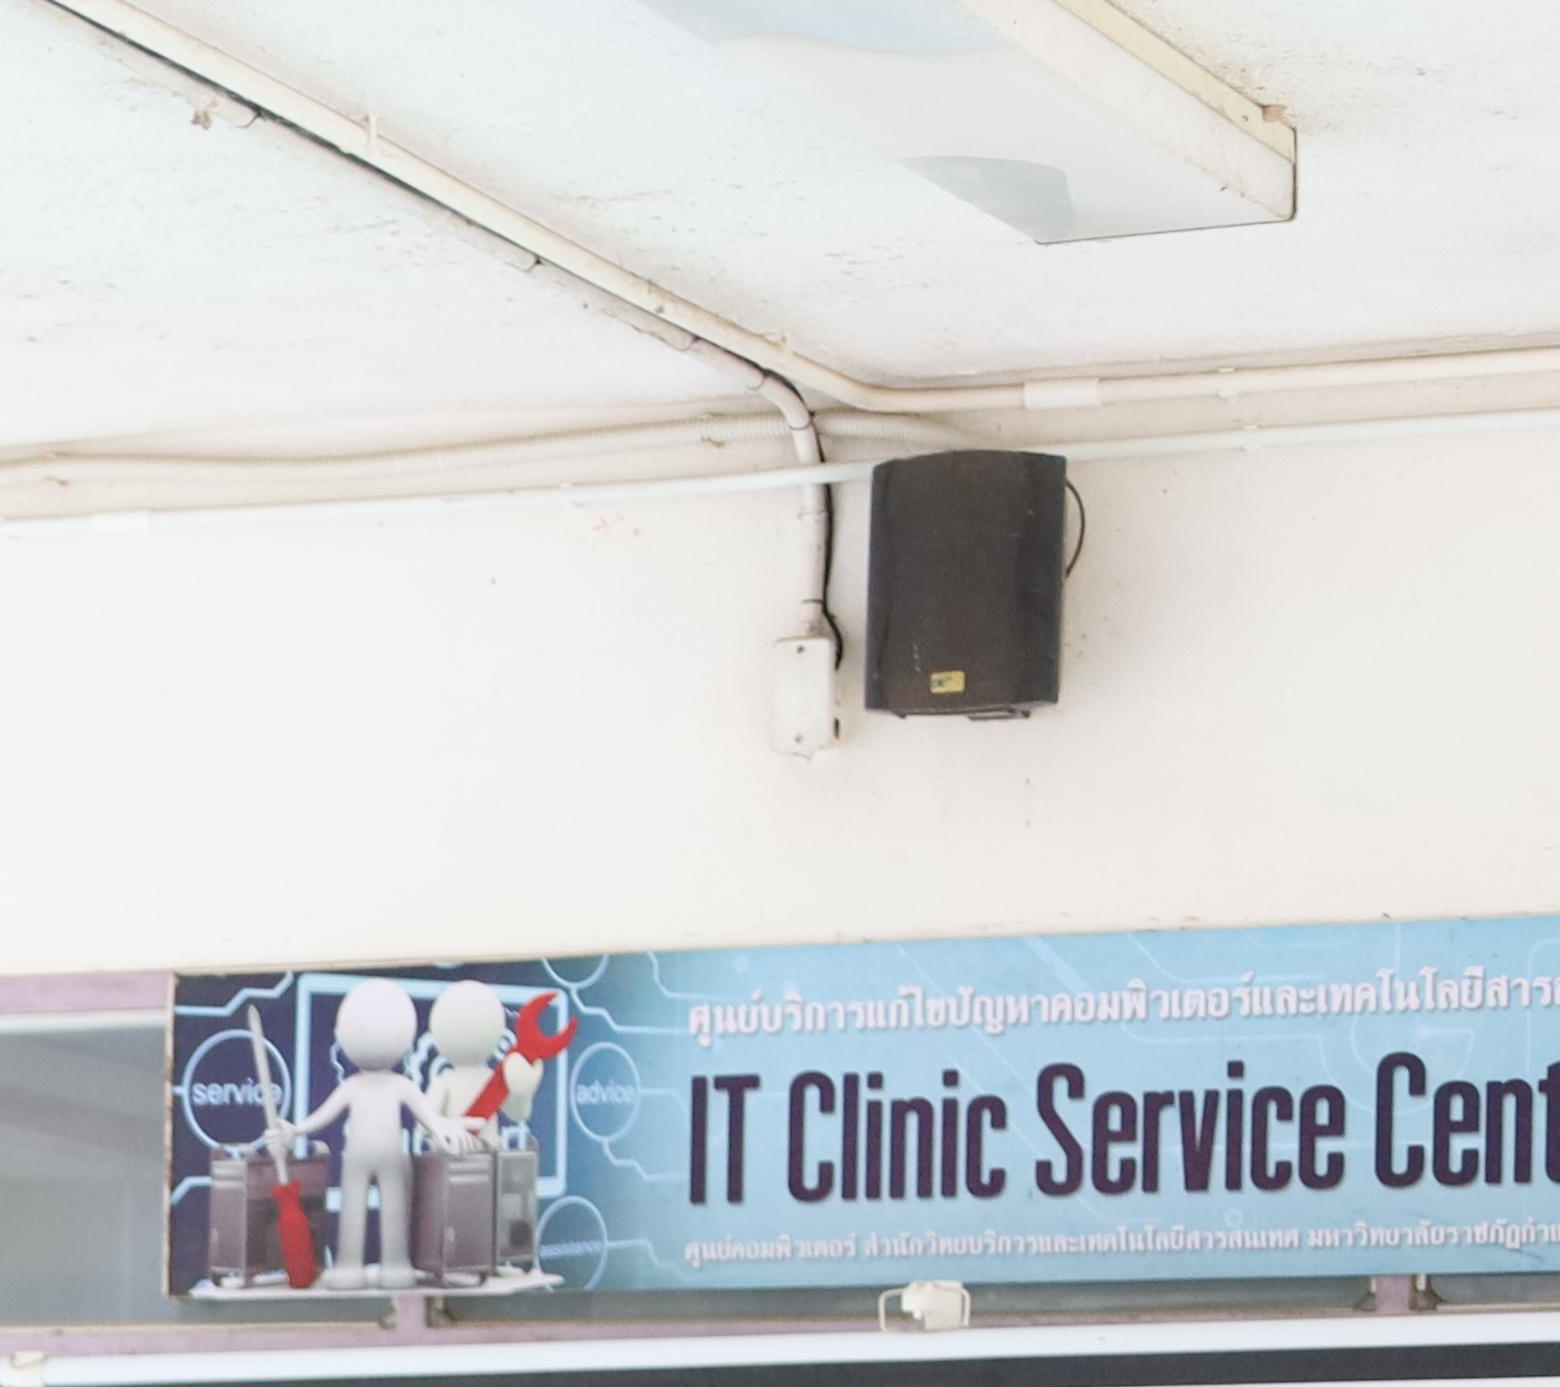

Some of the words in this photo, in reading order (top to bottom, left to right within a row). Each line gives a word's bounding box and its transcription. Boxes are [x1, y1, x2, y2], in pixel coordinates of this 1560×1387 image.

[192, 1076, 283, 1106] service
[690, 1073, 761, 1203] IT
[787, 1069, 1007, 1201] Clinic
[1035, 1050, 1346, 1197] Service
